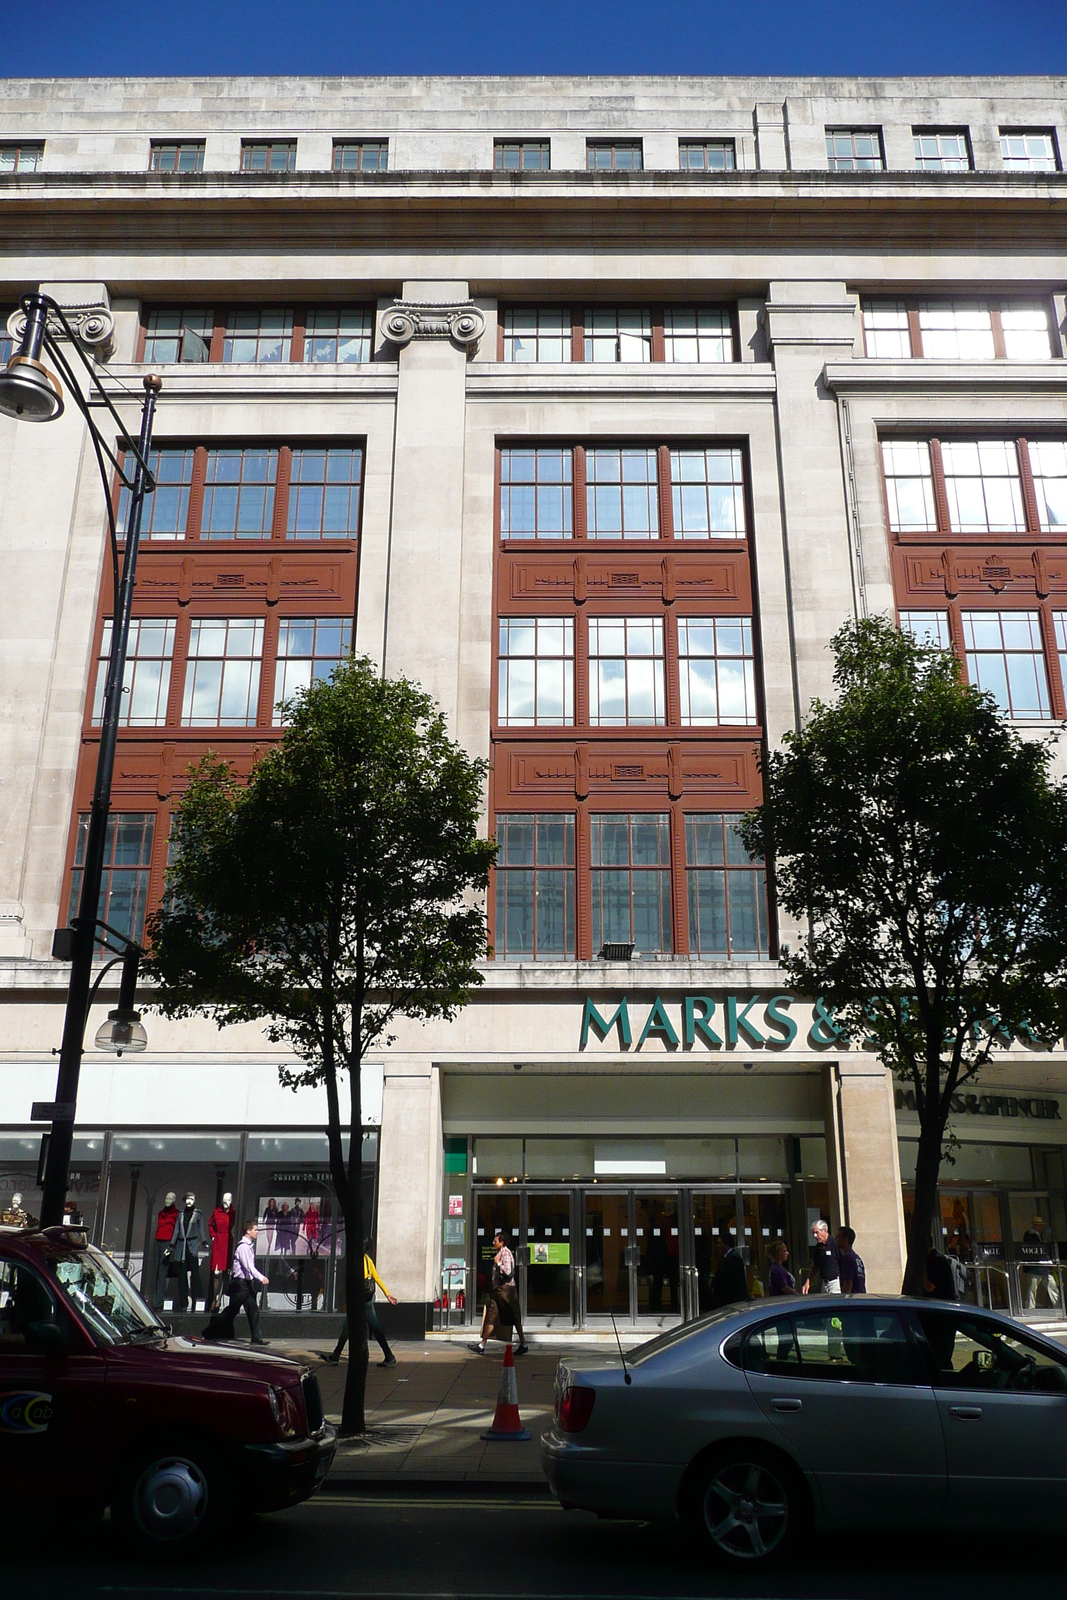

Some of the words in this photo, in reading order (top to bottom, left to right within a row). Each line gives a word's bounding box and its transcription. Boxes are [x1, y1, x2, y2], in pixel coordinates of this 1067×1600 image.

[581, 994, 798, 1045] MARKS
[811, 995, 852, 1045] &
[979, 1094, 1063, 1120] SPENCER
[273, 1173, 300, 1181] TRAINS
[303, 1173, 313, 1181] TO
[1021, 1247, 1046, 1255] VOGUE
